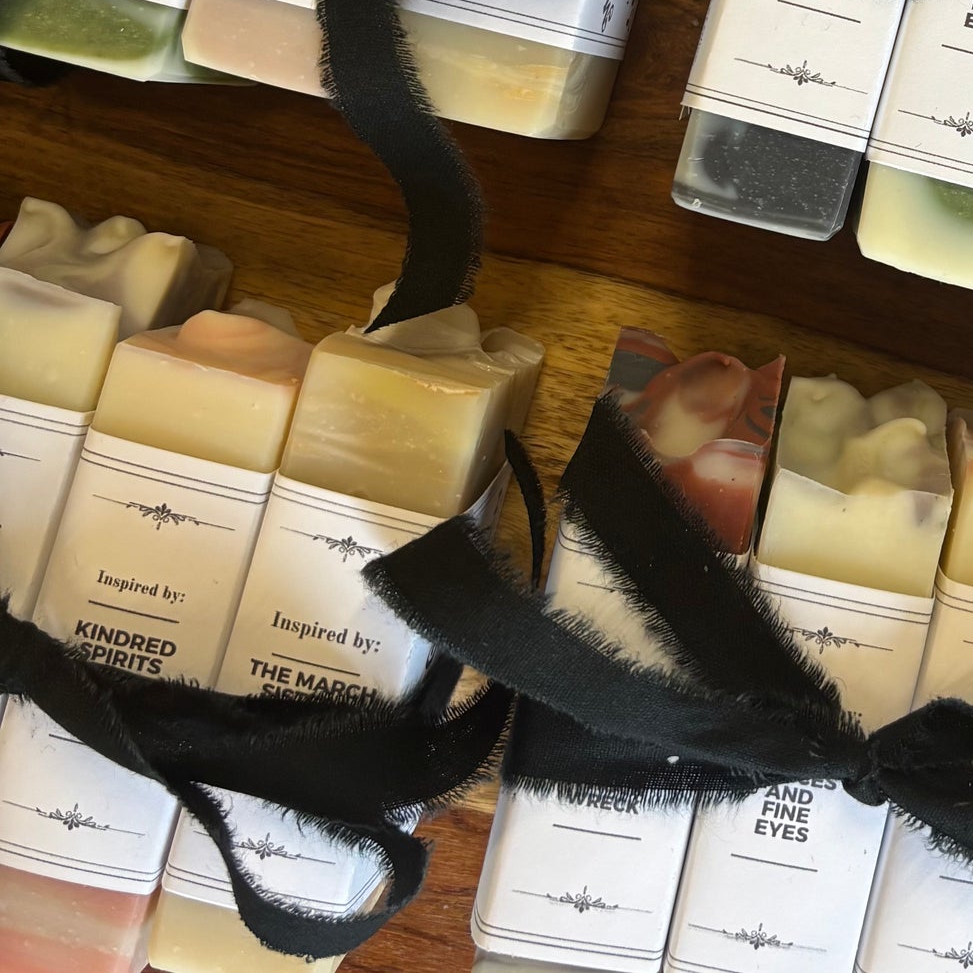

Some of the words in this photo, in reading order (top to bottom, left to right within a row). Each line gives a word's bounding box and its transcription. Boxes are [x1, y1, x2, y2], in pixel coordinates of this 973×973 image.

[96, 569, 159, 597] Inspired
[162, 585, 186, 605] by:
[74, 619, 177, 658] KINDRED
[271, 610, 348, 645] Inspired
[353, 631, 381, 655] by:
[79, 641, 164, 675] SPIRITS
[250, 658, 293, 685] THE
[295, 670, 378, 705] MARCH
[761, 800, 811, 824] FINE
[764, 785, 814, 806] AND
[753, 818, 810, 843] EYES
